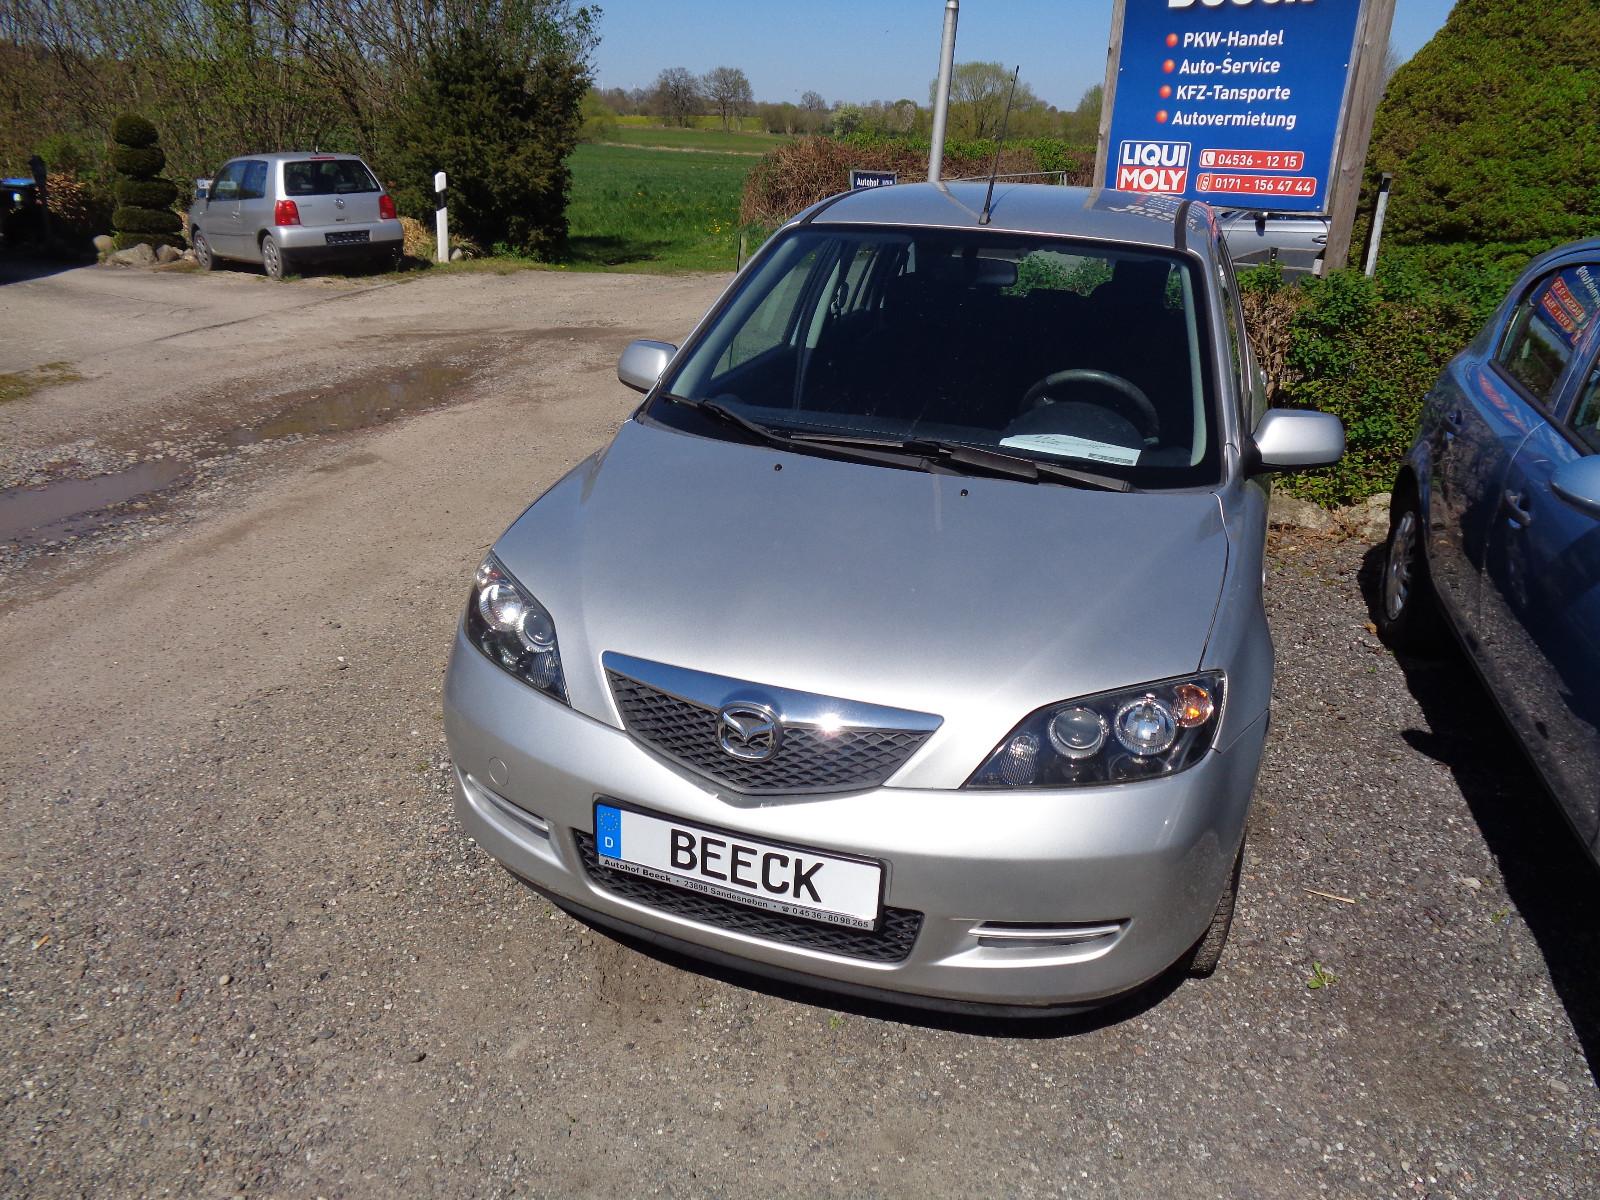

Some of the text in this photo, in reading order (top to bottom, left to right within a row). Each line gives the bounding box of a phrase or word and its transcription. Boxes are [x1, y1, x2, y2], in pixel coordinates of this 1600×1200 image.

[1183, 29, 1285, 48] PKW-Handel
[1178, 58, 1281, 75] Auto-Service
[1175, 84, 1292, 104] KFZ-Tansporte
[1171, 111, 1297, 131] Autovermietung
[1122, 143, 1187, 167] LIQUI
[1218, 154, 1254, 166] 04536
[1266, 155, 1279, 167] 12
[1283, 156, 1297, 168] 15
[1119, 168, 1186, 191] MOLY
[1215, 178, 1241, 190] 0171
[1254, 180, 1274, 190] 156
[1277, 181, 1292, 191] 47
[1295, 181, 1311, 193] 44
[604, 836, 614, 848] D
[669, 827, 825, 903] BEECK
[604, 859, 640, 874] Autohof
[642, 868, 671, 882] Beeck
[684, 880, 708, 893] 23898
[710, 887, 768, 908] Sandesneben
